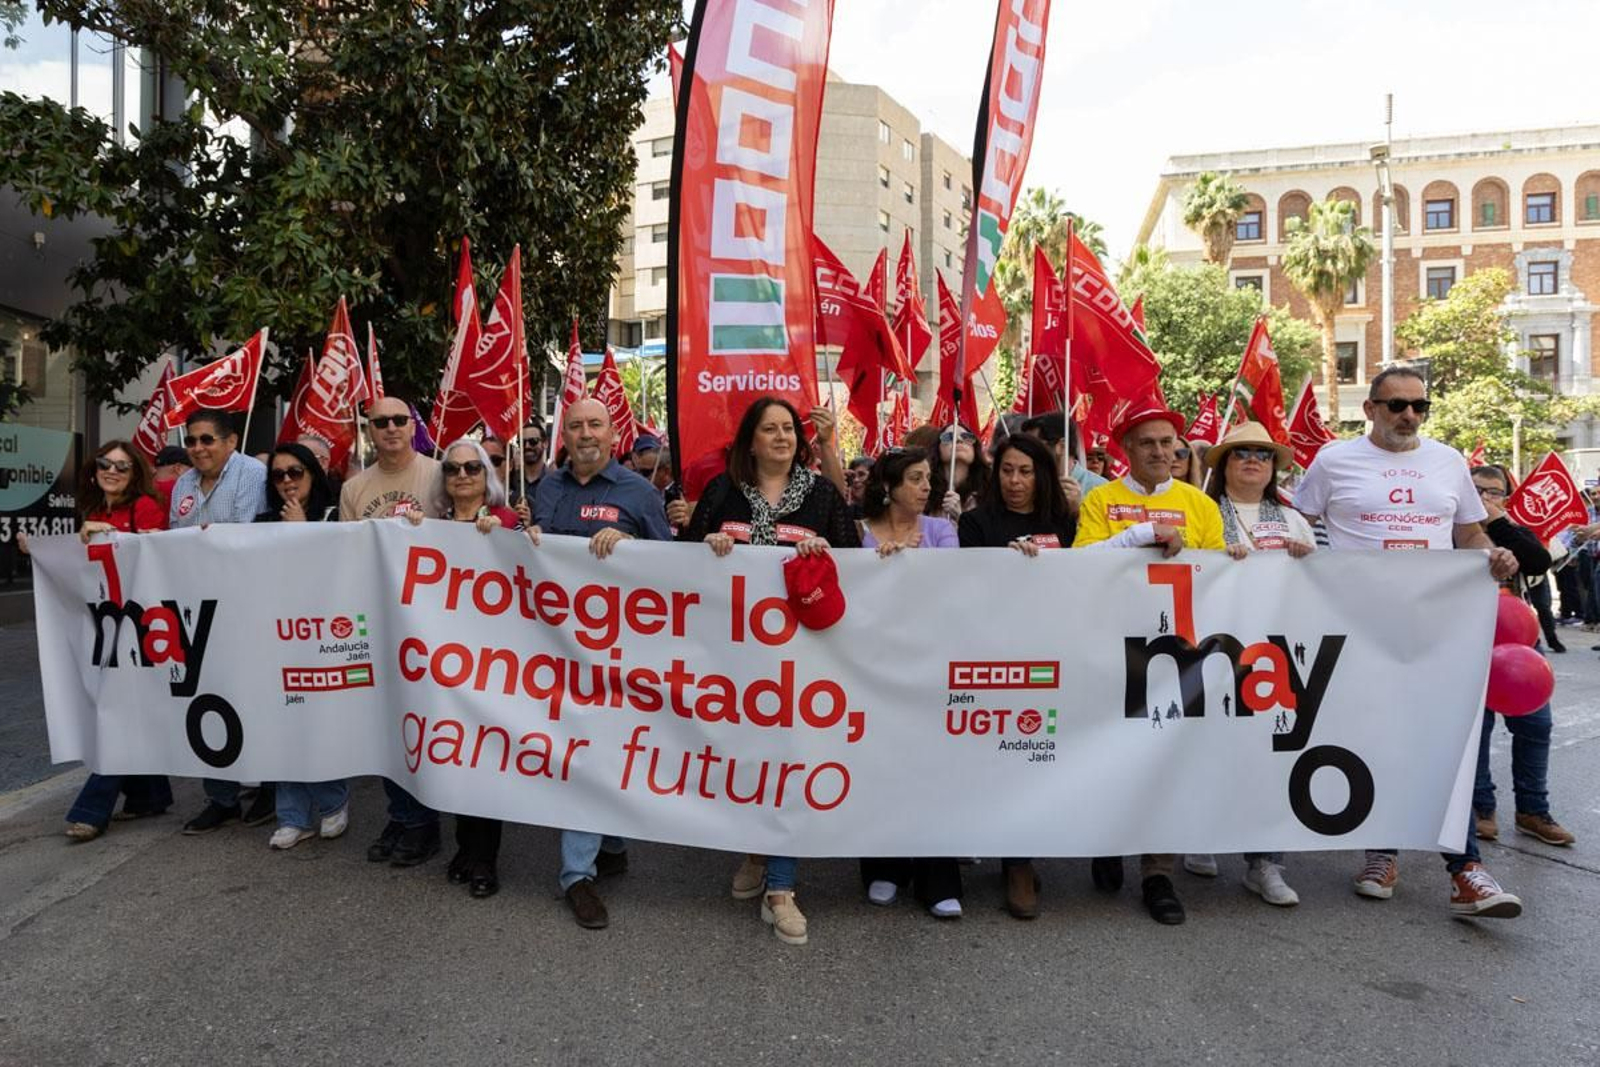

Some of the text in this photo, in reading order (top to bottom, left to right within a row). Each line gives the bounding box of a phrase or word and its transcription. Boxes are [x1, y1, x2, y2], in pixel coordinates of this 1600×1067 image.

[697, 370, 801, 394] Servicios
[1400, 469, 1426, 480] SOY
[1388, 488, 1416, 505] C1
[400, 545, 799, 651] Proteger lo
[276, 617, 325, 641] UGT
[319, 640, 370, 655] Andalucía
[345, 650, 370, 661] Jaén
[286, 670, 344, 688] CCOO
[954, 665, 1026, 684] CCOO
[399, 635, 867, 744] conquistado,
[285, 693, 305, 706] Jaén
[946, 692, 975, 706] Jaén
[946, 708, 1012, 735] UGT
[998, 738, 1056, 752] Andalucía
[401, 711, 852, 812] ganar futuro
[1027, 751, 1056, 762] Jaén
